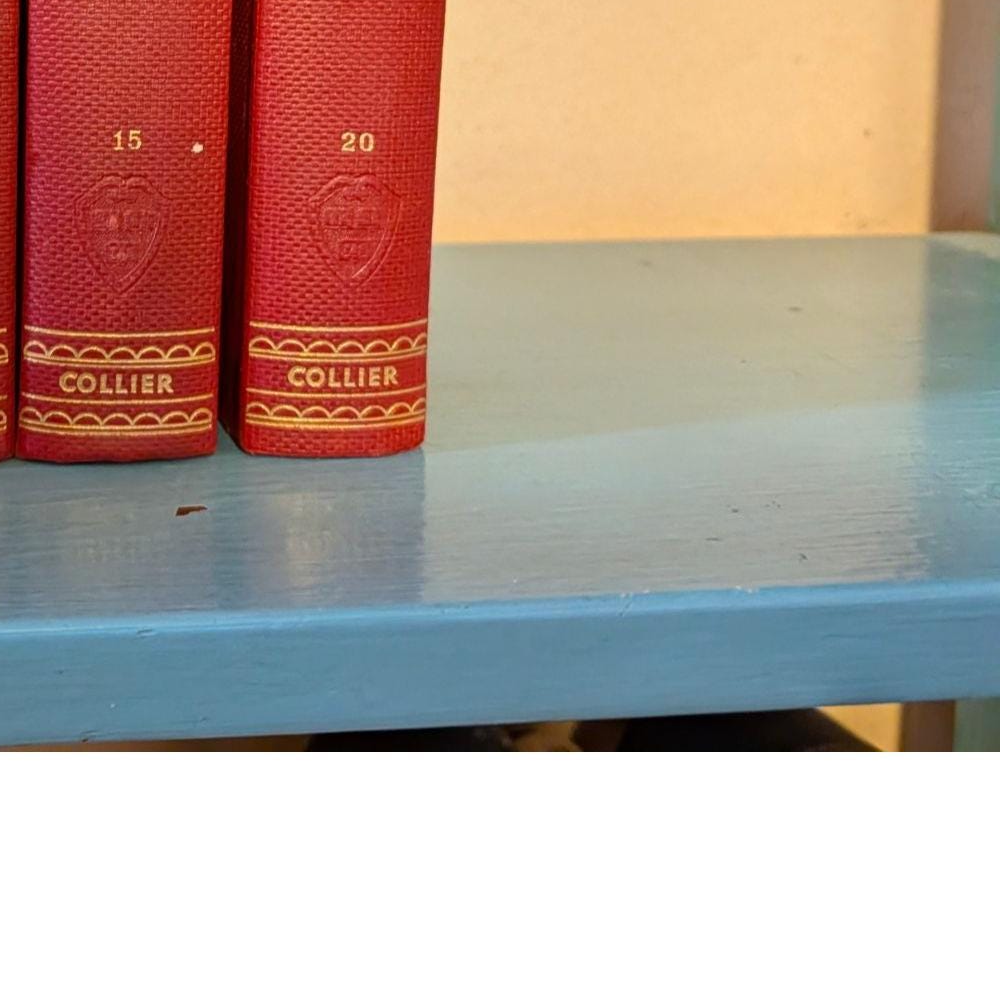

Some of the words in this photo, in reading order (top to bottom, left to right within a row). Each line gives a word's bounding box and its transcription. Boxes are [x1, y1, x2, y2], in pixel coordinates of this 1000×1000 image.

[112, 129, 142, 151] 15
[340, 131, 376, 153] 20
[59, 371, 175, 396] COLLIER
[287, 365, 400, 389] COLLIER
